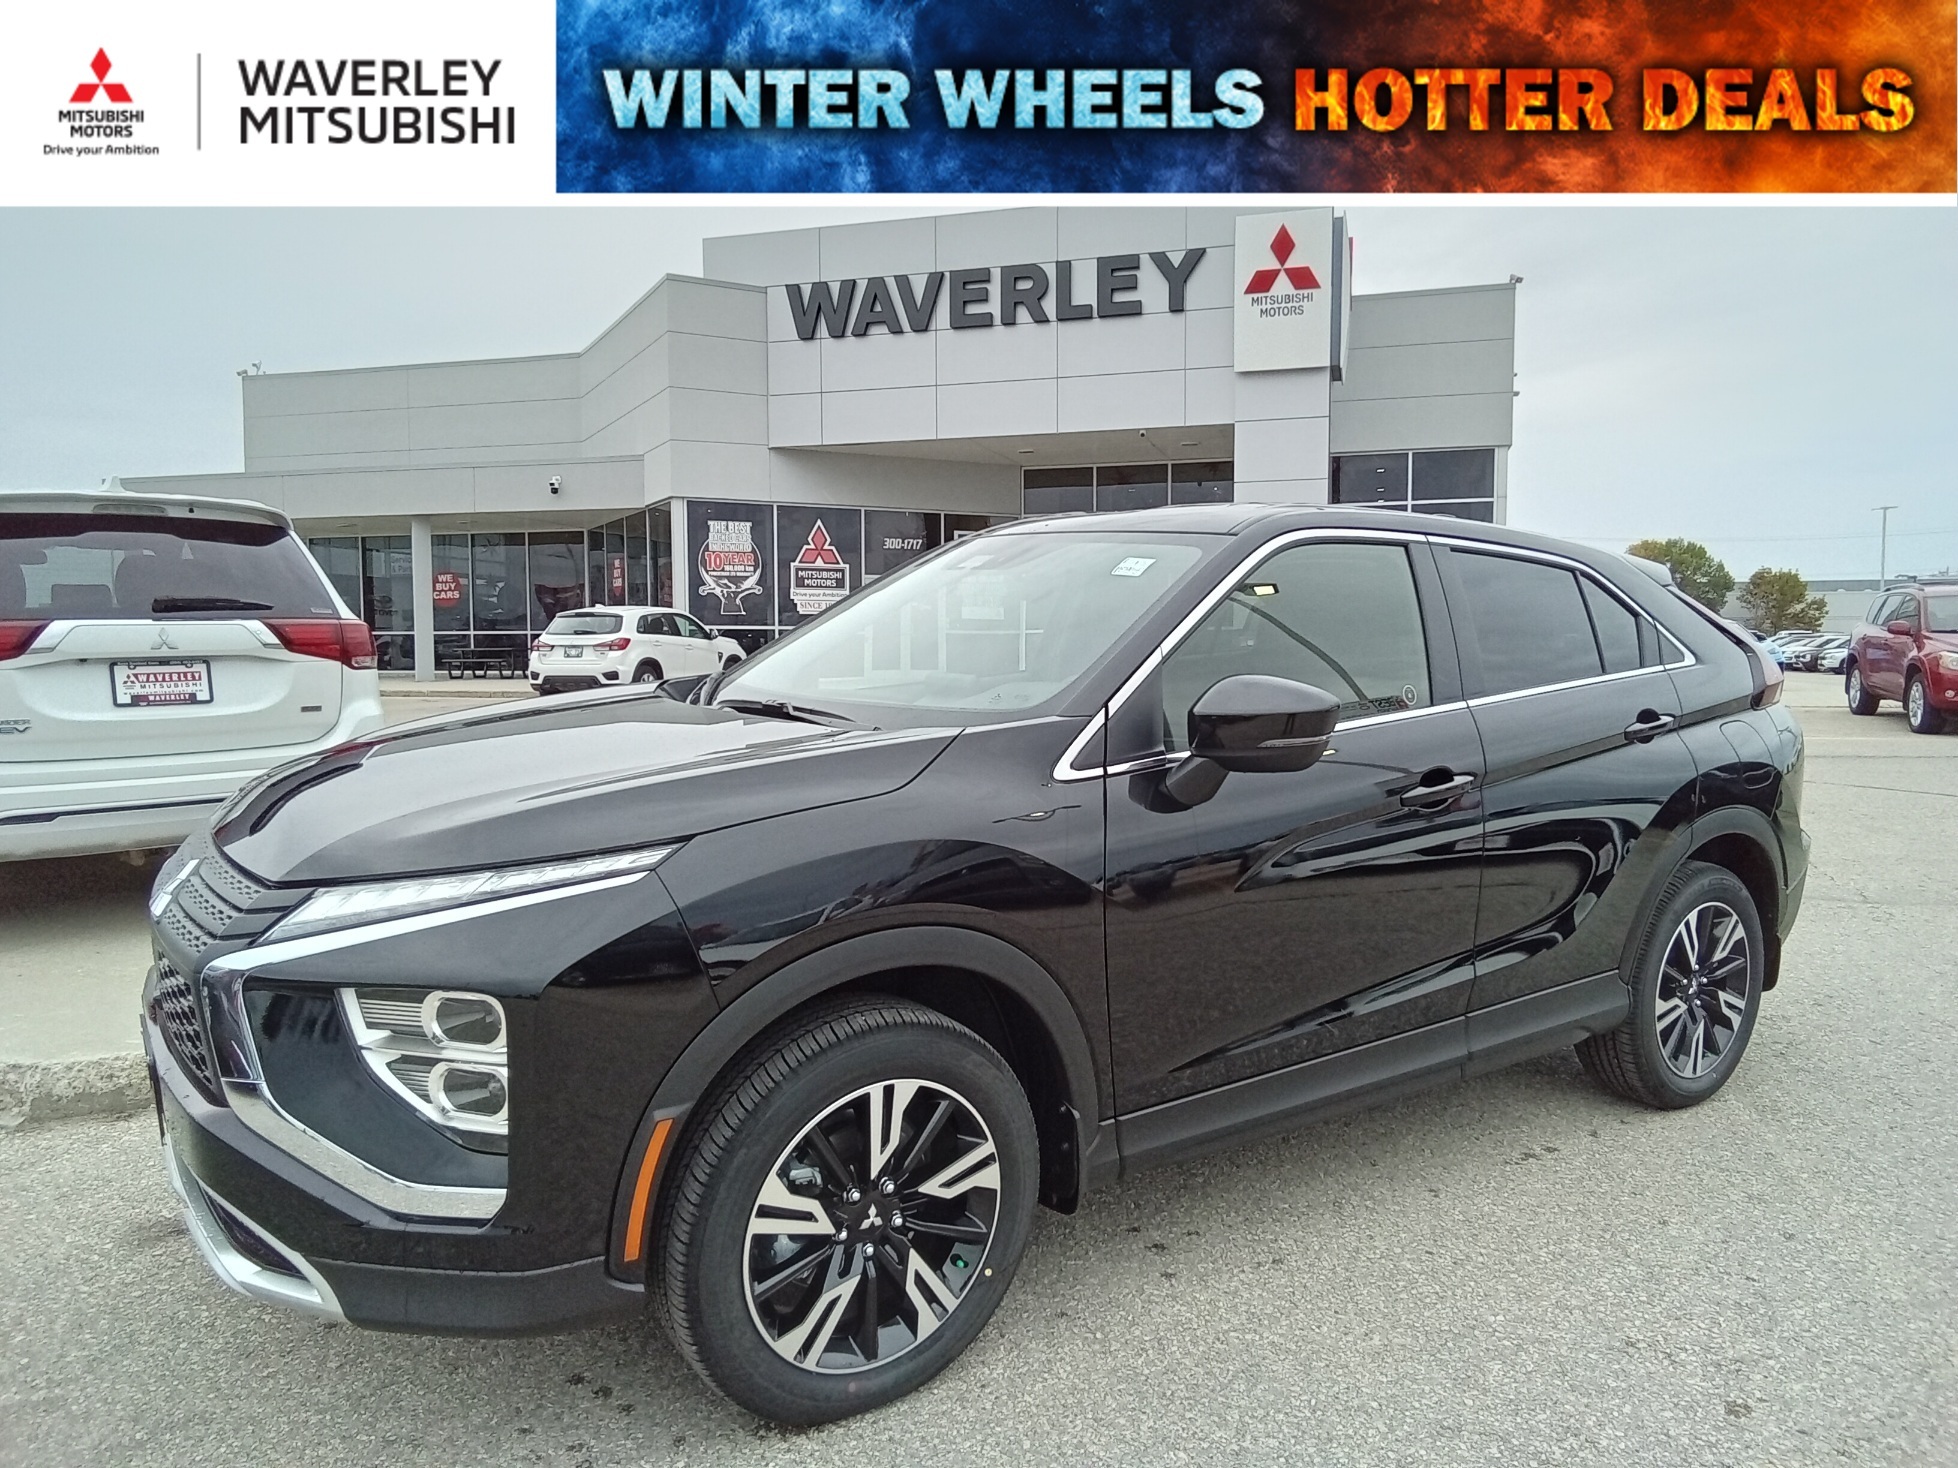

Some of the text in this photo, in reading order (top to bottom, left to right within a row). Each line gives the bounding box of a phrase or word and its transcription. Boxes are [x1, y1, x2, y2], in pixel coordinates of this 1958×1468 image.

[785, 248, 1207, 340] WAVERLEY
[1250, 291, 1314, 307] MITSUBISHI
[1259, 304, 1305, 318] MOTORS
[707, 520, 753, 535] THE BEST
[882, 537, 923, 550] 300-1717
[705, 552, 755, 571] 10 YEAR
[437, 574, 454, 582] WE
[798, 570, 843, 579] MITSUBISHI
[435, 582, 457, 591] BUY
[804, 578, 837, 587] MOTORS
[433, 590, 460, 599] CARS
[799, 601, 823, 610] SINCE
[137, 671, 201, 683] WAVERLEY
[139, 682, 203, 690] MITSUBISHI
[147, 693, 190, 701] WAVERLEY
